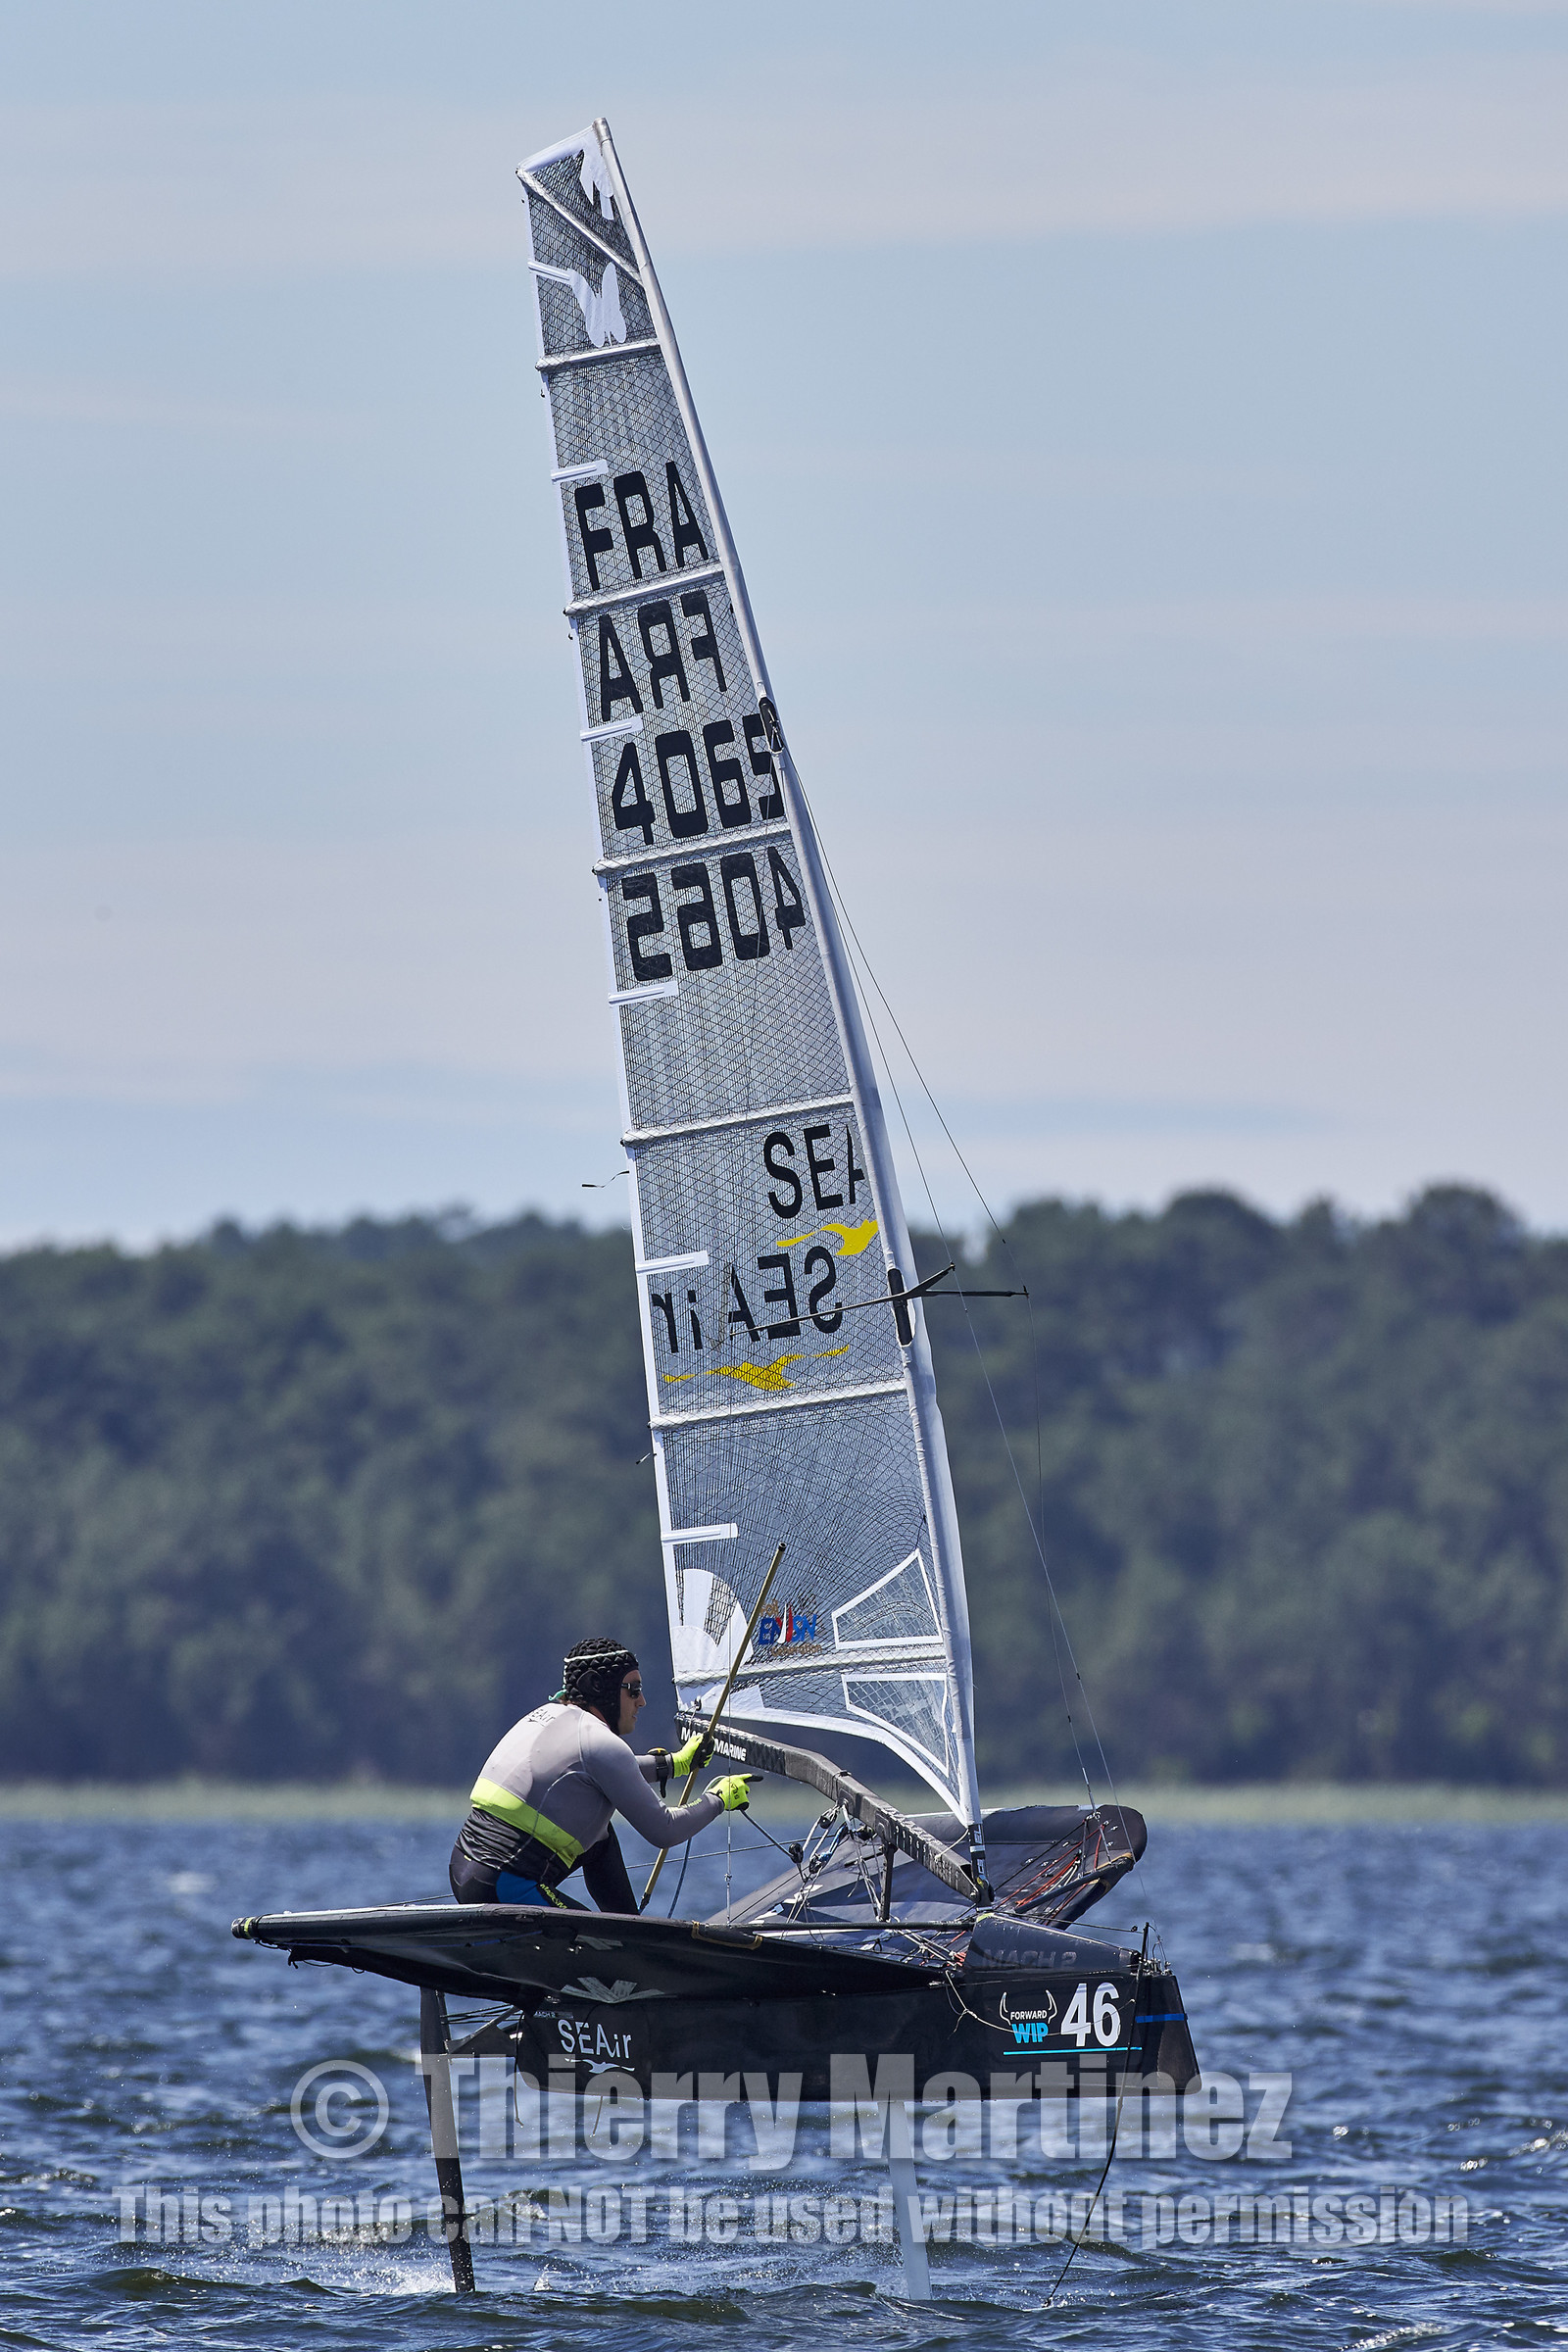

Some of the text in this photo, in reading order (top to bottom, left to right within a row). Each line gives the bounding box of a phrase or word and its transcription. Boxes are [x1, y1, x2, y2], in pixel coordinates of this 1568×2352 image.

[574, 461, 709, 590] FRA
[612, 712, 784, 845] 4065
[713, 1738, 747, 1762] MARINE
[1010, 2010, 1048, 2021] FORWARD
[1011, 2022, 1049, 2044] WIP
[1060, 1982, 1122, 2047] 46
[558, 2019, 632, 2059] SEAir
